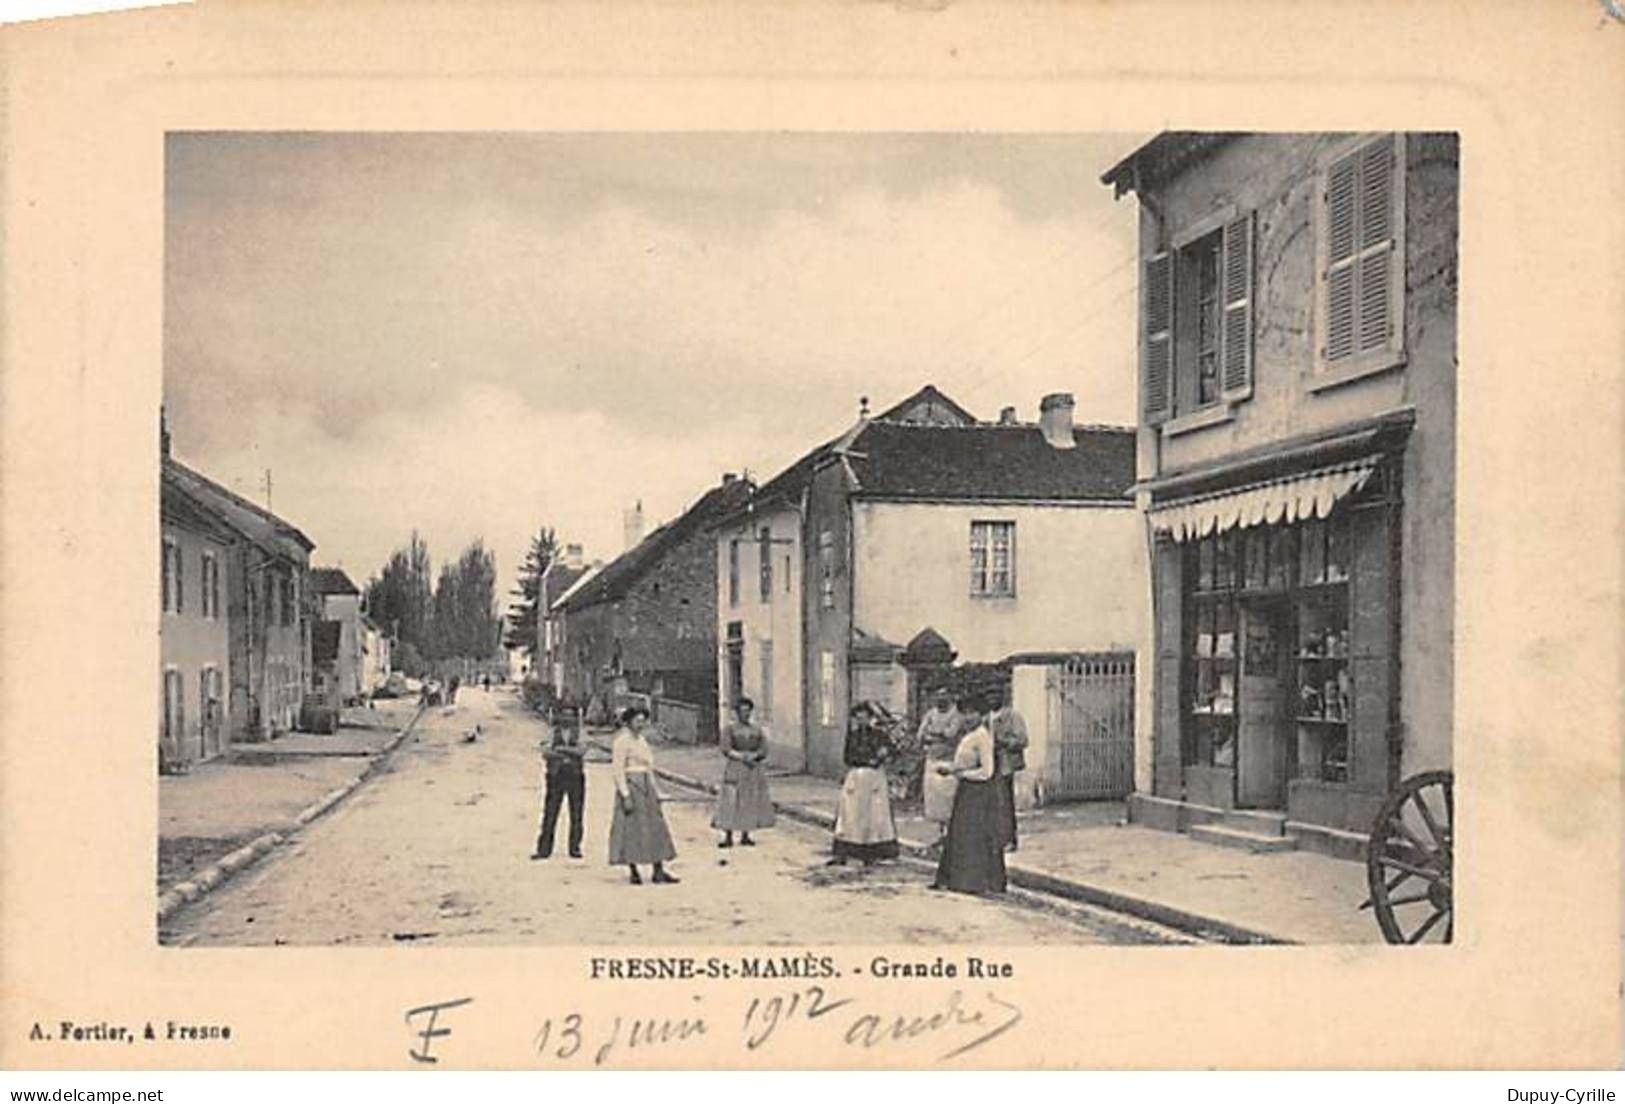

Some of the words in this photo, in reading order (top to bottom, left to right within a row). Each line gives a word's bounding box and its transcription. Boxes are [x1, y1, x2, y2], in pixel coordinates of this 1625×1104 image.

[538, 1013, 583, 1058] 13
[595, 995, 706, 1066] juin
[745, 986, 853, 1051] 1912
